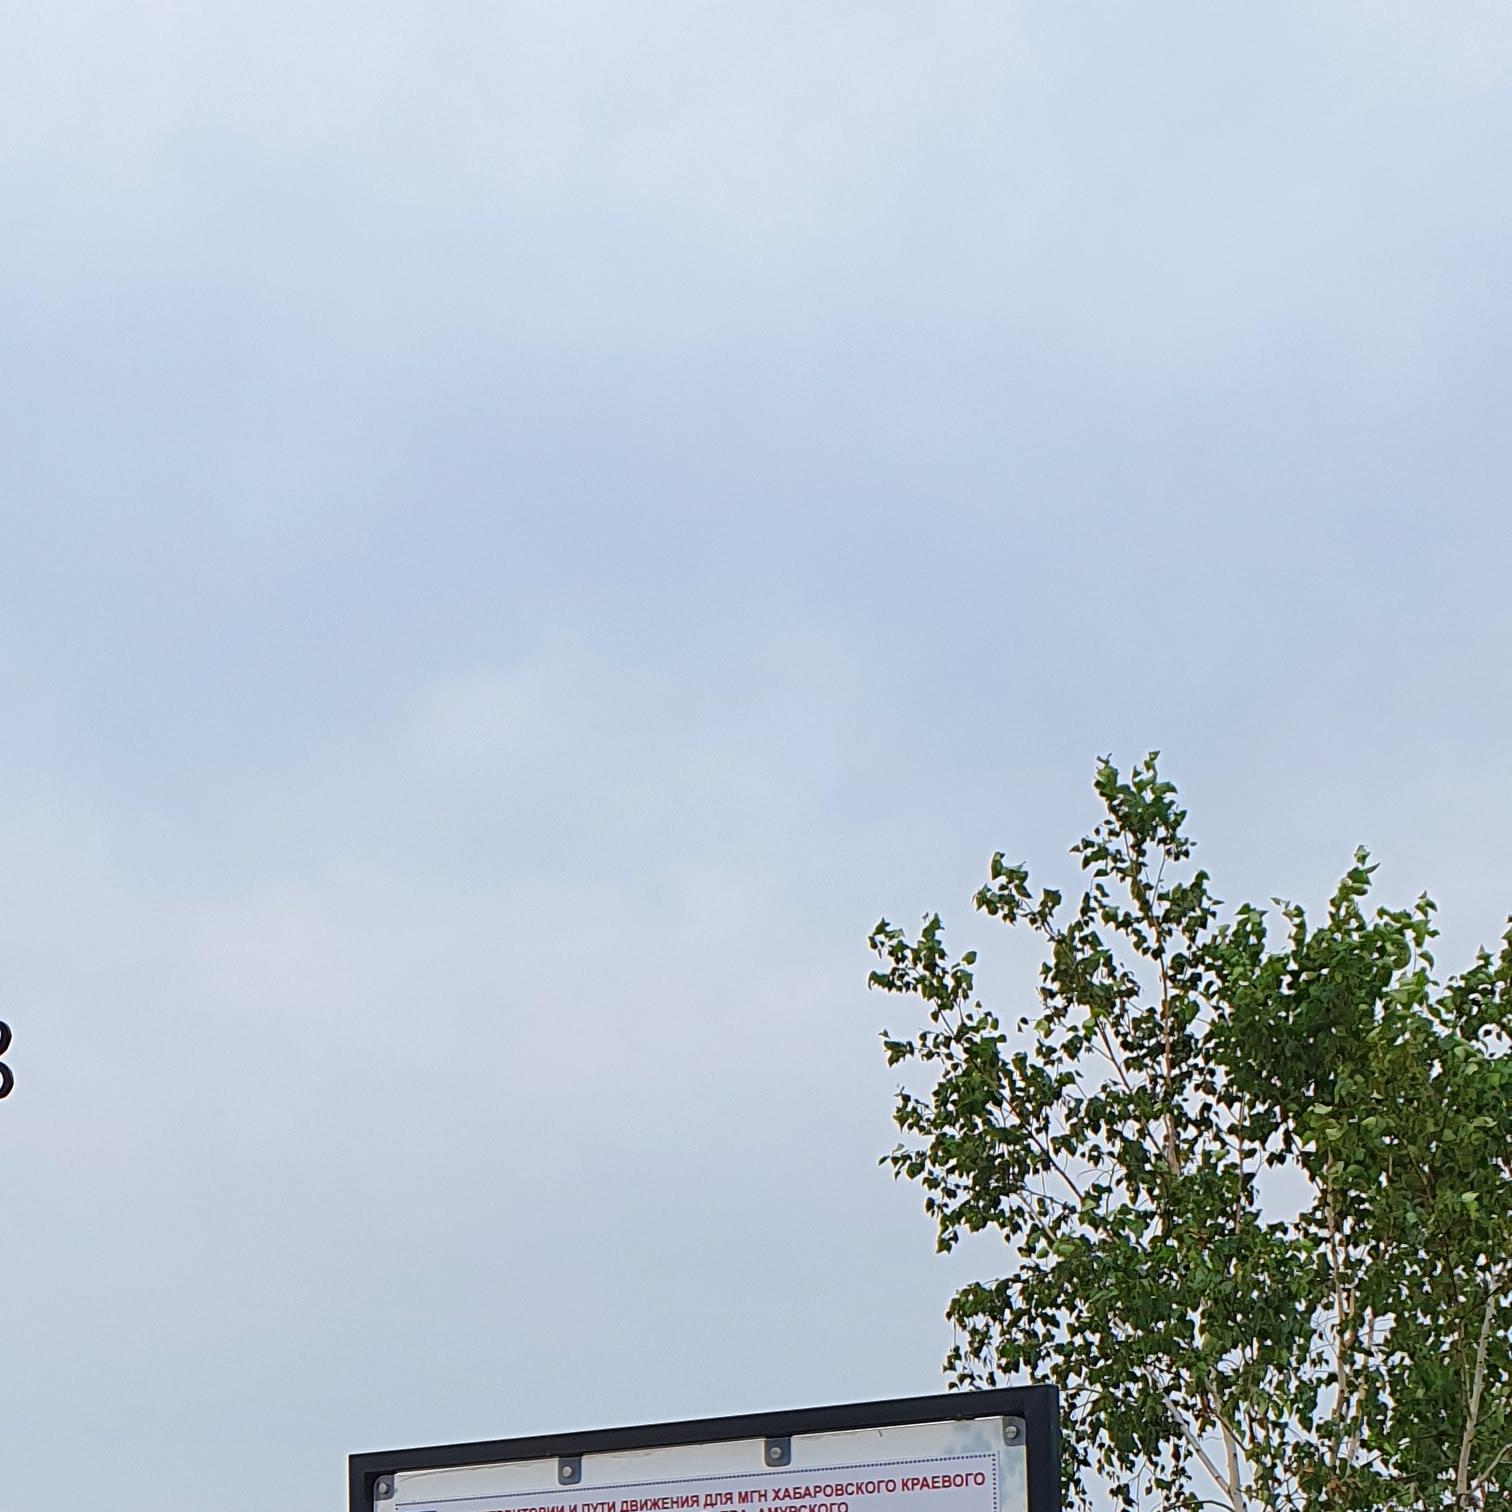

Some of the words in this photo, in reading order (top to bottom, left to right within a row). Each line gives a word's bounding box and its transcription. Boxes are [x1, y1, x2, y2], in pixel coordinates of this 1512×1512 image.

[703, 1492, 734, 1508] ДЛЯ
[738, 1489, 768, 1505] МГН
[771, 1479, 896, 1502] ХАБАРОВСКОГО
[900, 1472, 986, 1492] КРАЕВОГО
